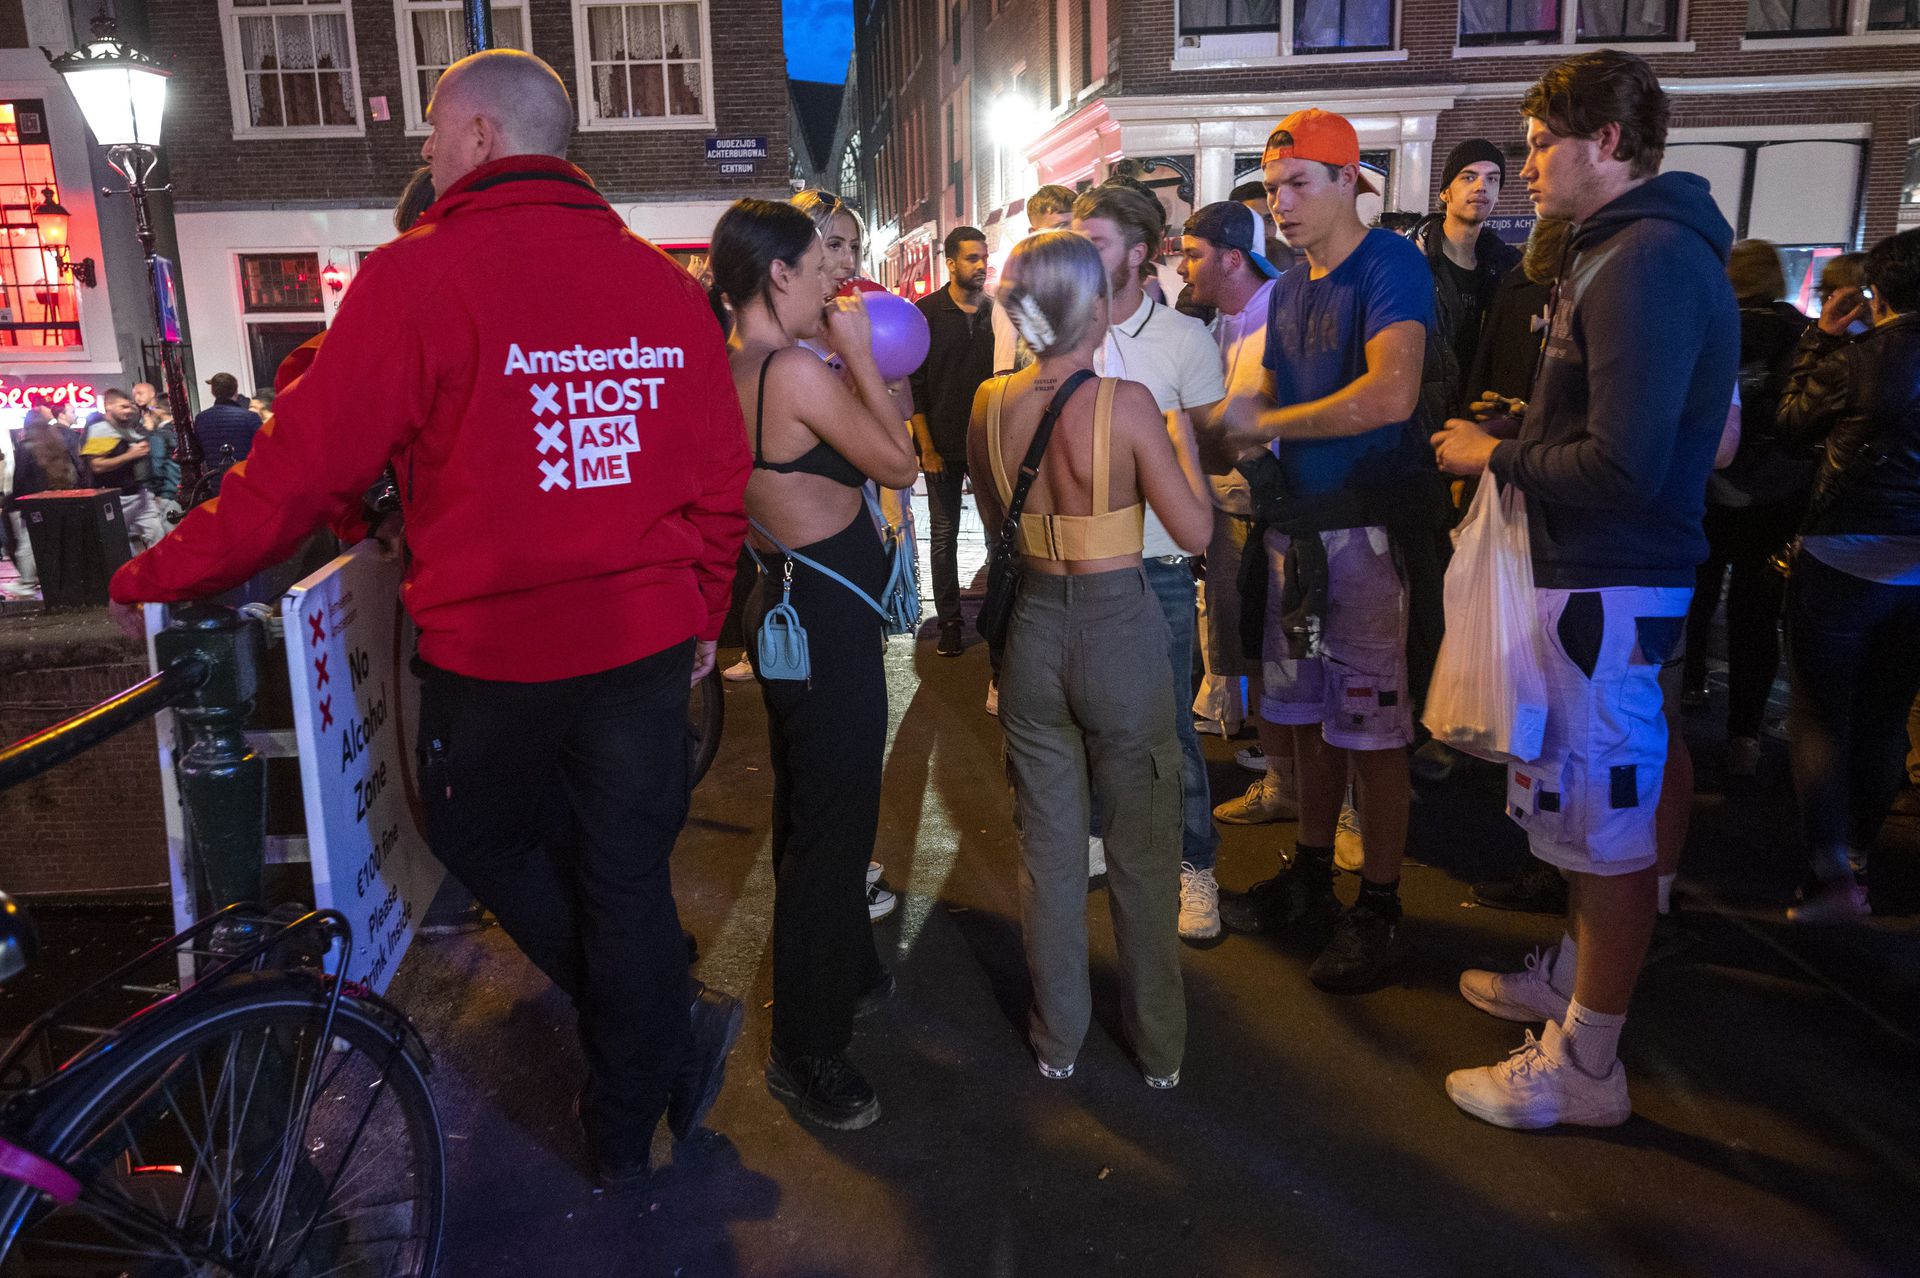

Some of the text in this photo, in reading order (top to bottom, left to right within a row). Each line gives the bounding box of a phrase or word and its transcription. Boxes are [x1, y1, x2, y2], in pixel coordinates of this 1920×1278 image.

[707, 148, 767, 159] ACHTERBURGWAL
[716, 139, 757, 148] OUDEZIJDS
[721, 164, 753, 173] CENTRUM
[1514, 219, 1537, 229] ACHT
[504, 336, 685, 376] Amsterdam
[565, 377, 665, 415] HOST
[579, 422, 635, 449] ASK
[581, 454, 625, 482] ME
[348, 646, 370, 692] No
[341, 681, 388, 774] Alcohol
[354, 760, 387, 824] Zone
[356, 823, 399, 898] €100 fine
[368, 883, 398, 944] Please
[387, 901, 413, 952] Inside
